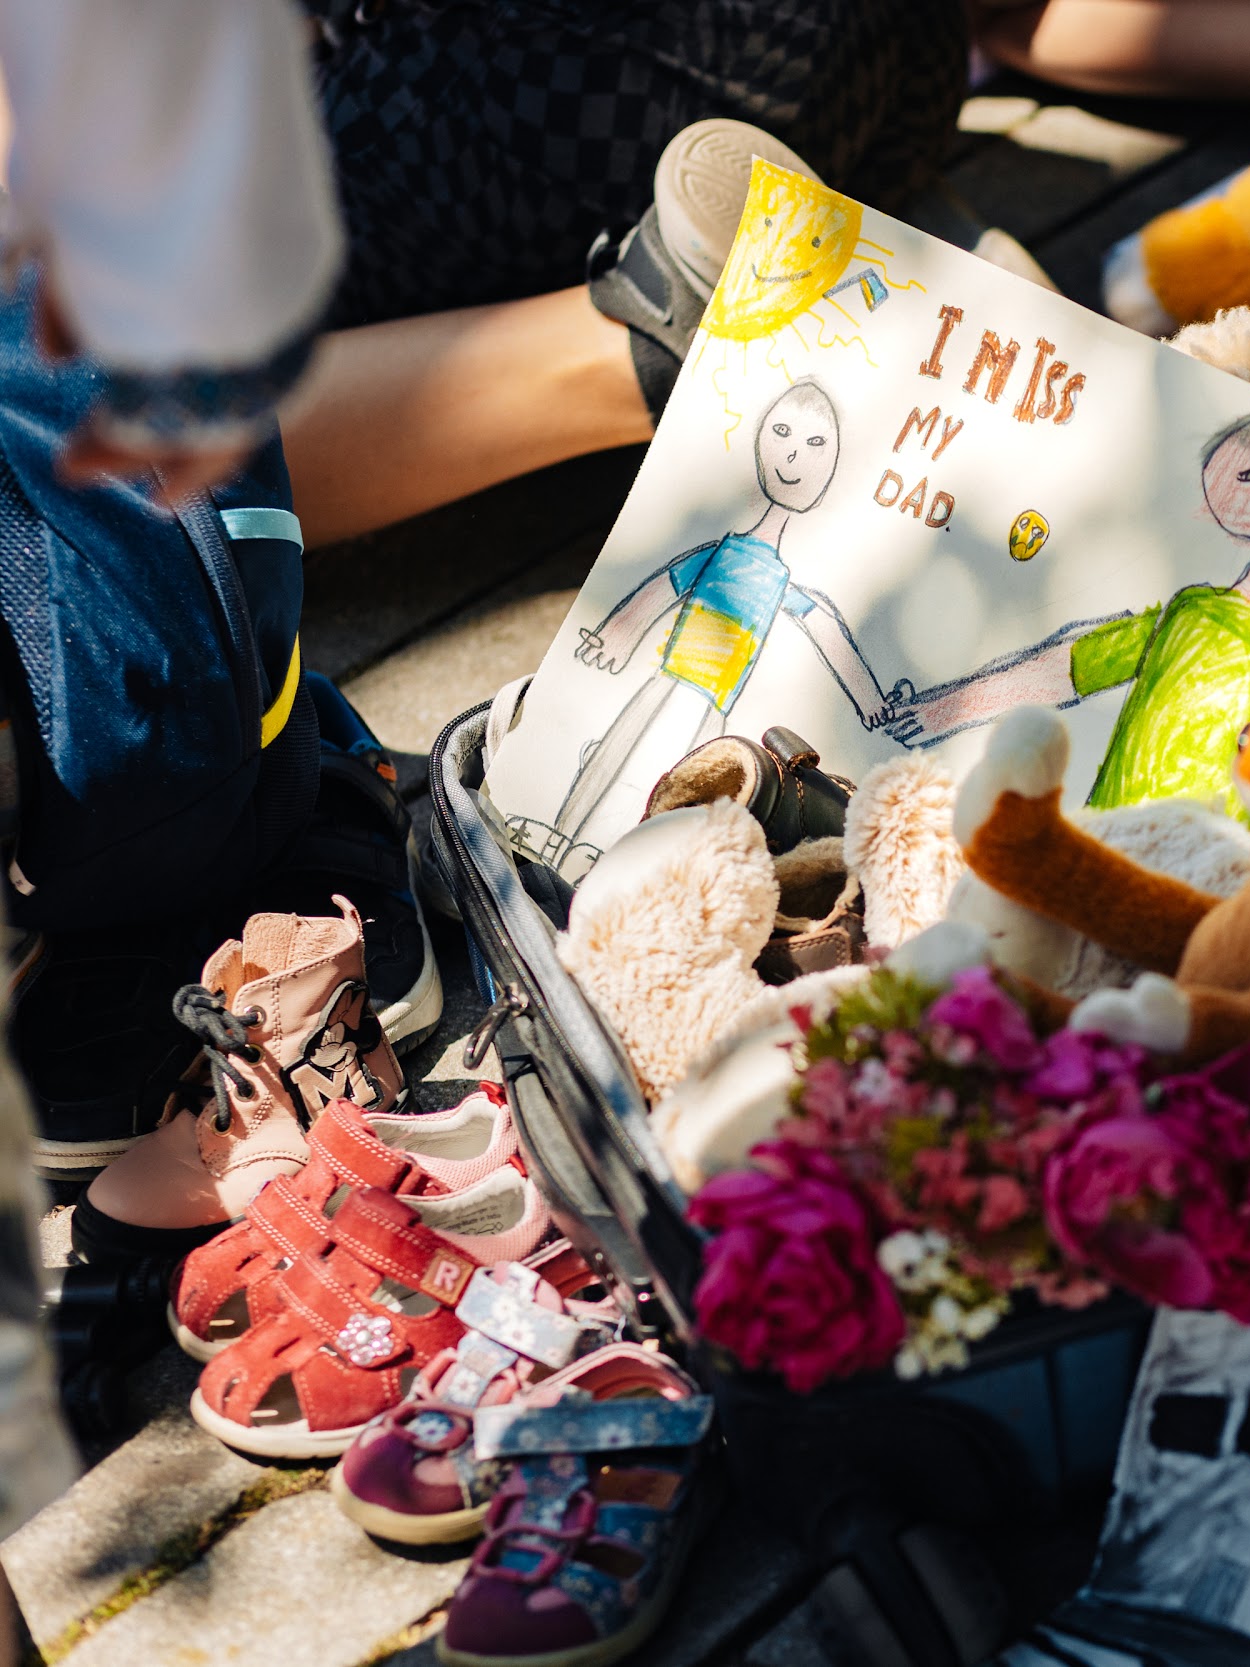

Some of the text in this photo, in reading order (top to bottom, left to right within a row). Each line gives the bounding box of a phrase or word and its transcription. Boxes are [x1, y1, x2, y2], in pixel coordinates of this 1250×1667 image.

[918, 304, 965, 380] I
[892, 405, 965, 462] MY
[433, 1260, 461, 1294] R
